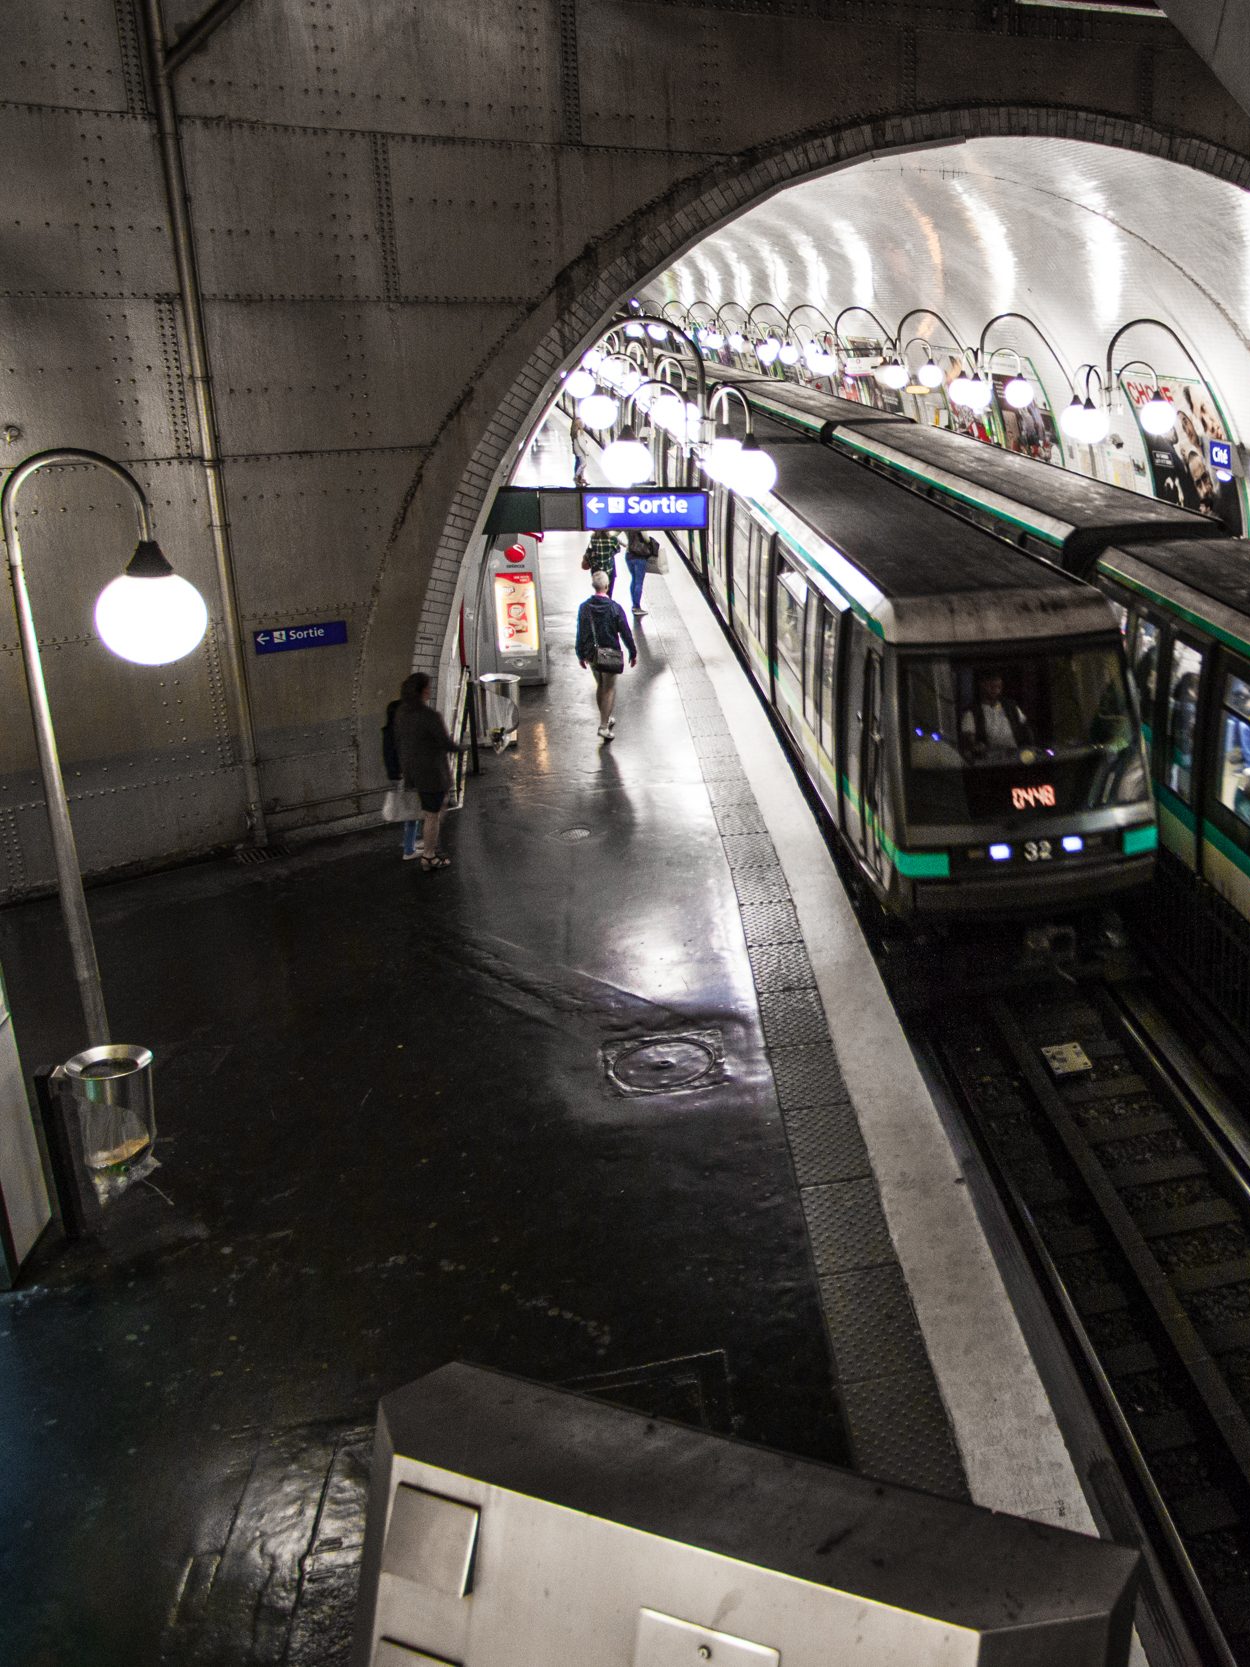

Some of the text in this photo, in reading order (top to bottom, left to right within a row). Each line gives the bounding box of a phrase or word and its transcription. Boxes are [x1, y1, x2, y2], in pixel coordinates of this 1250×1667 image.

[1212, 446, 1228, 465] Cité
[627, 495, 688, 514] Sortie
[289, 627, 325, 640] Sortie
[1024, 840, 1052, 861] 32
